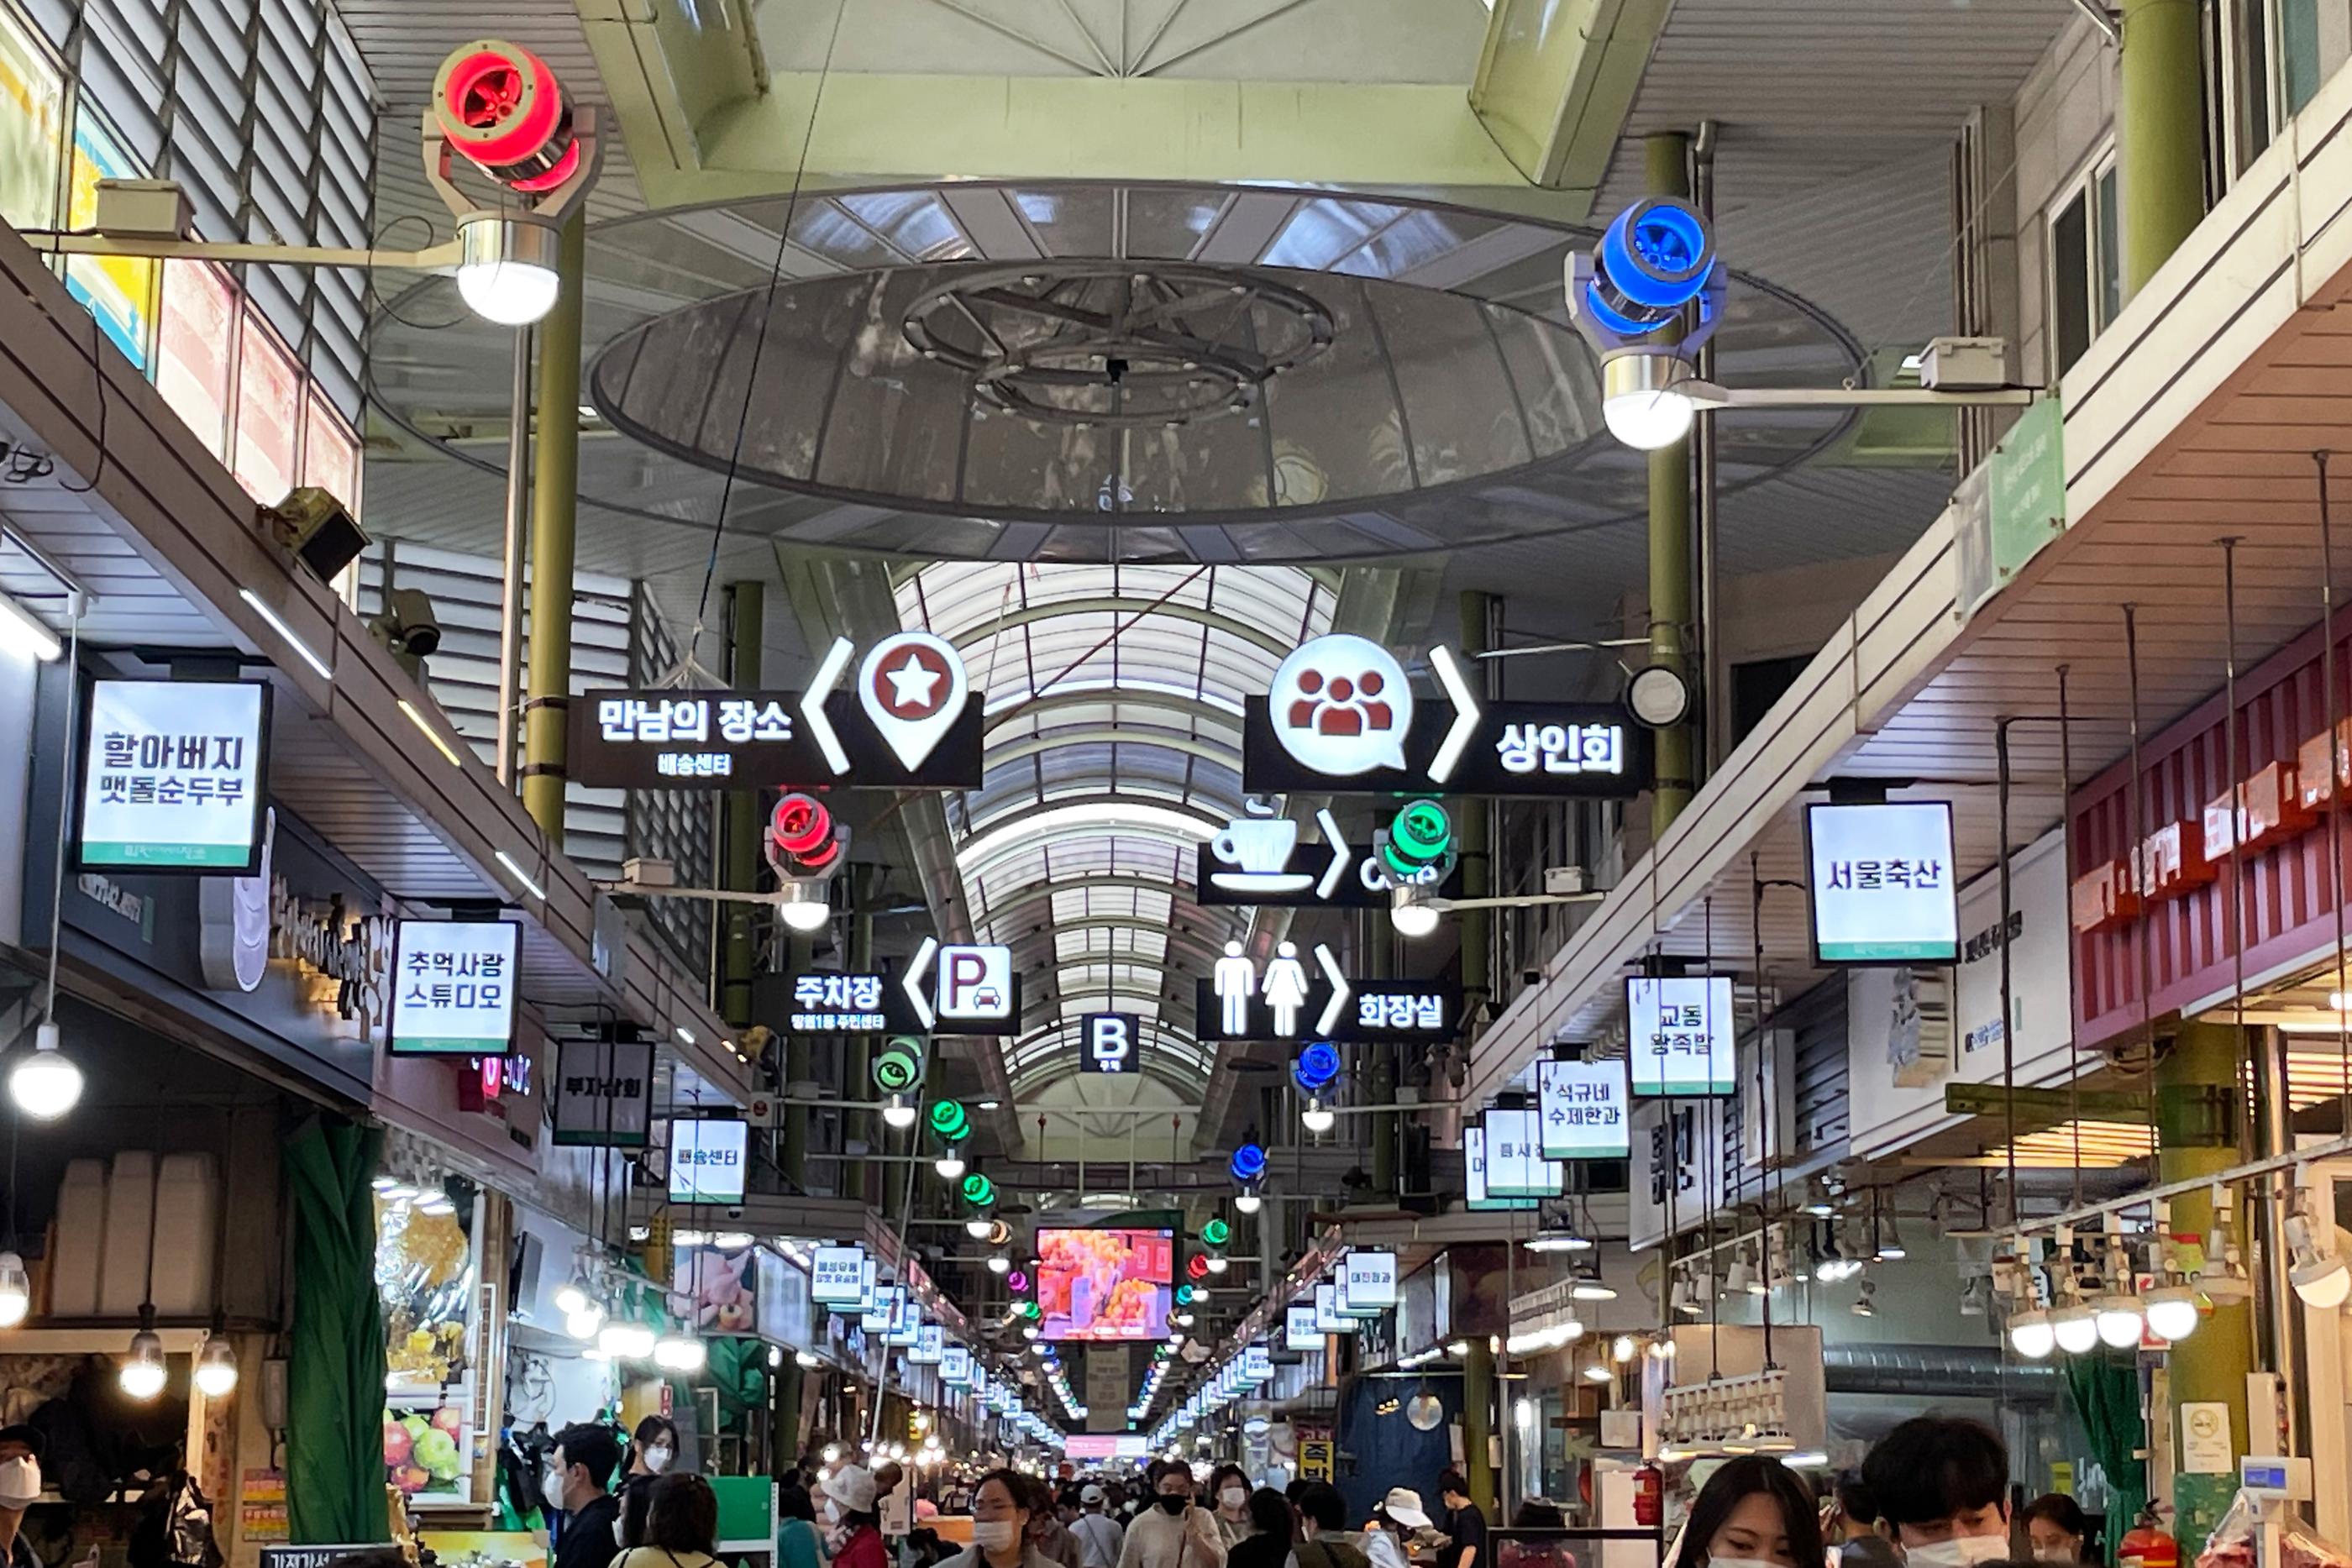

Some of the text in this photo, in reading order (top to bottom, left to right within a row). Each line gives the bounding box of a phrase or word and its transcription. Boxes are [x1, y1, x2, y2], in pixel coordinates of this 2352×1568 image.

[600, 700, 792, 742] 만남의 장소
[103, 732, 243, 770] 할아버지
[658, 753, 731, 776] 배송센터
[1496, 724, 1623, 774] 상인회
[100, 774, 244, 806] 맷돌순두부
[1827, 859, 1941, 890] 서울축산
[407, 951, 505, 978] 추억사랑
[404, 983, 501, 1009] 스튜디오
[795, 975, 883, 1010] 주차장
[950, 952, 988, 1009] P
[1358, 994, 1442, 1028] 화장실
[1660, 1004, 1702, 1027] 교동
[1093, 1018, 1129, 1060] B
[1651, 1033, 1715, 1056] 왕족발
[565, 1077, 641, 1099] 부자상회
[1557, 1083, 1610, 1103] 석규네
[1548, 1105, 1621, 1126] 수제한과
